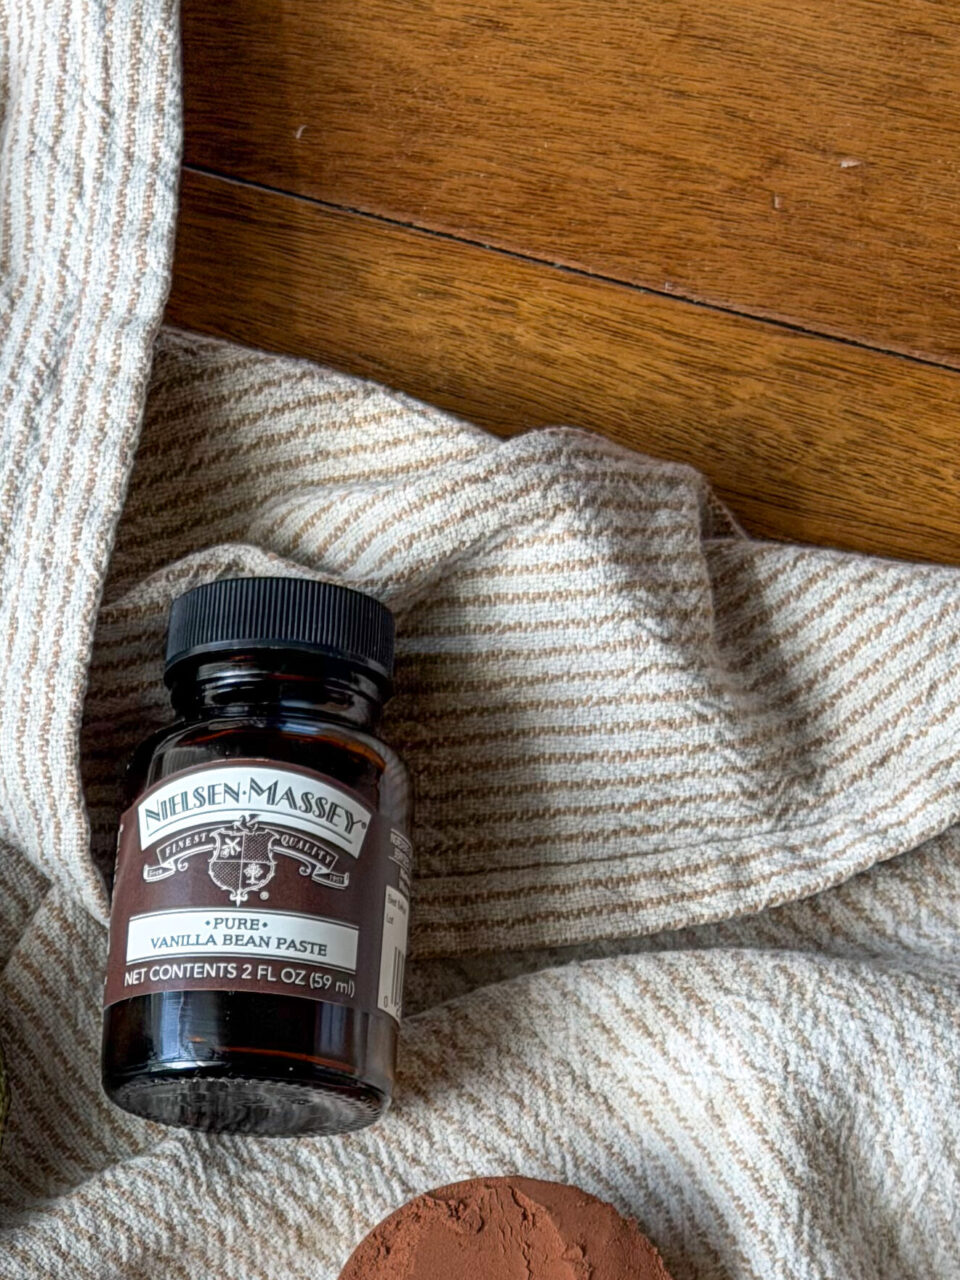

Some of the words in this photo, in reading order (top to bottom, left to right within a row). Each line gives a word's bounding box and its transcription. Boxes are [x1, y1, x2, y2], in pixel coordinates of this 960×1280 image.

[164, 832, 208, 857] FINEST
[280, 833, 333, 864] QUALITY
[213, 917, 260, 931] PURE
[151, 934, 217, 950] VANILLA
[222, 934, 270, 948] BEAN
[276, 937, 328, 957] PASTE
[124, 967, 147, 987] NET
[149, 962, 237, 982] CONTENTS
[241, 964, 252, 980] 2
[257, 965, 277, 982] FL
[281, 967, 306, 986] OZ
[309, 972, 332, 990] (59
[335, 979, 356, 998] ml)
